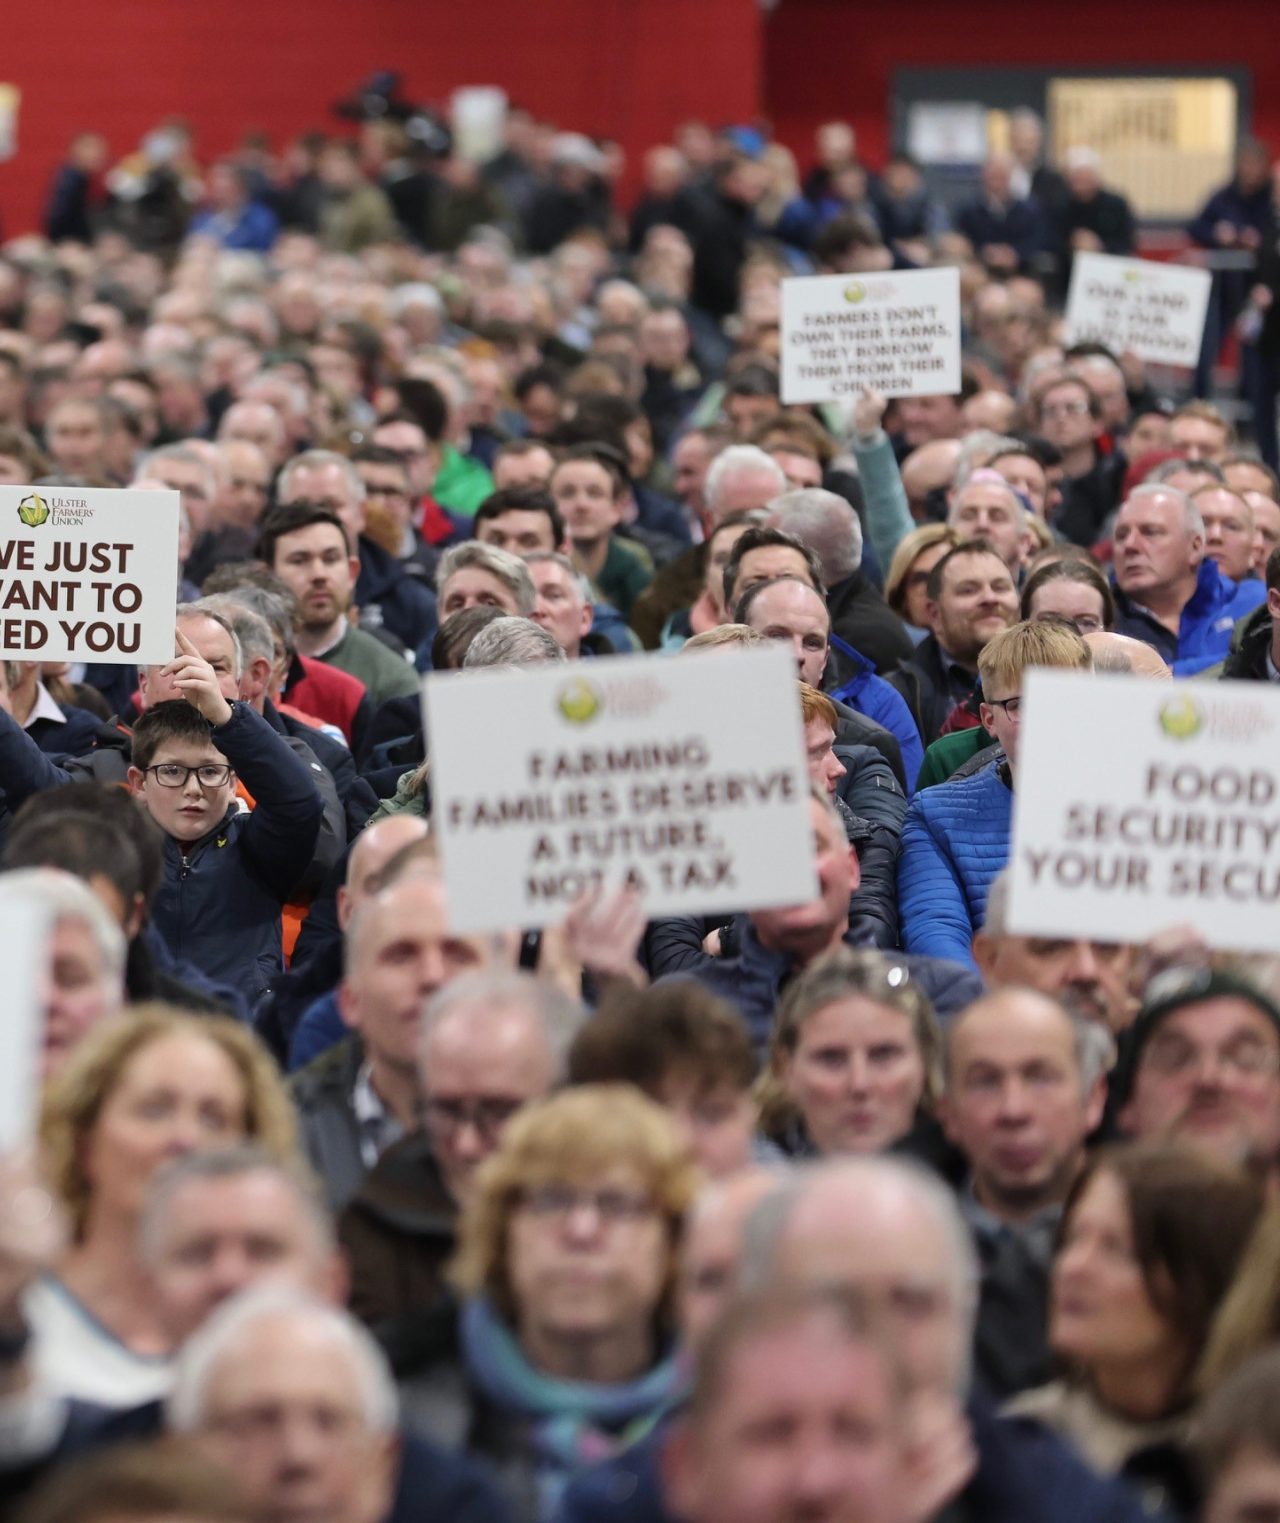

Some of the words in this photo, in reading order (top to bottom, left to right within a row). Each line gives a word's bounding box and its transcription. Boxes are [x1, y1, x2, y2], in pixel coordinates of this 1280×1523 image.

[803, 309, 881, 326] FARMERS
[885, 304, 938, 322] DON'T
[790, 329, 835, 347] OWN
[840, 326, 884, 343] THEIR
[810, 346, 849, 361] THEY
[855, 341, 935, 359] BORROW
[798, 363, 843, 380] THEM
[847, 360, 896, 377] FROM
[901, 356, 945, 373] THEIR
[52, 498, 87, 508] ULSTER
[52, 516, 83, 526] UNION
[44, 541, 134, 574] JUST
[91, 581, 143, 614] TO
[58, 620, 141, 653] YOU
[527, 737, 711, 781] FARMING
[445, 787, 619, 830] FAMILIES
[629, 769, 798, 814] DESERVE
[1145, 762, 1279, 806] FOOD
[531, 832, 557, 863] A
[566, 820, 724, 860] FUTURE,
[526, 865, 604, 902] NOT
[622, 862, 650, 894] A
[659, 856, 738, 891] TAX
[1022, 845, 1150, 892] YOUR
